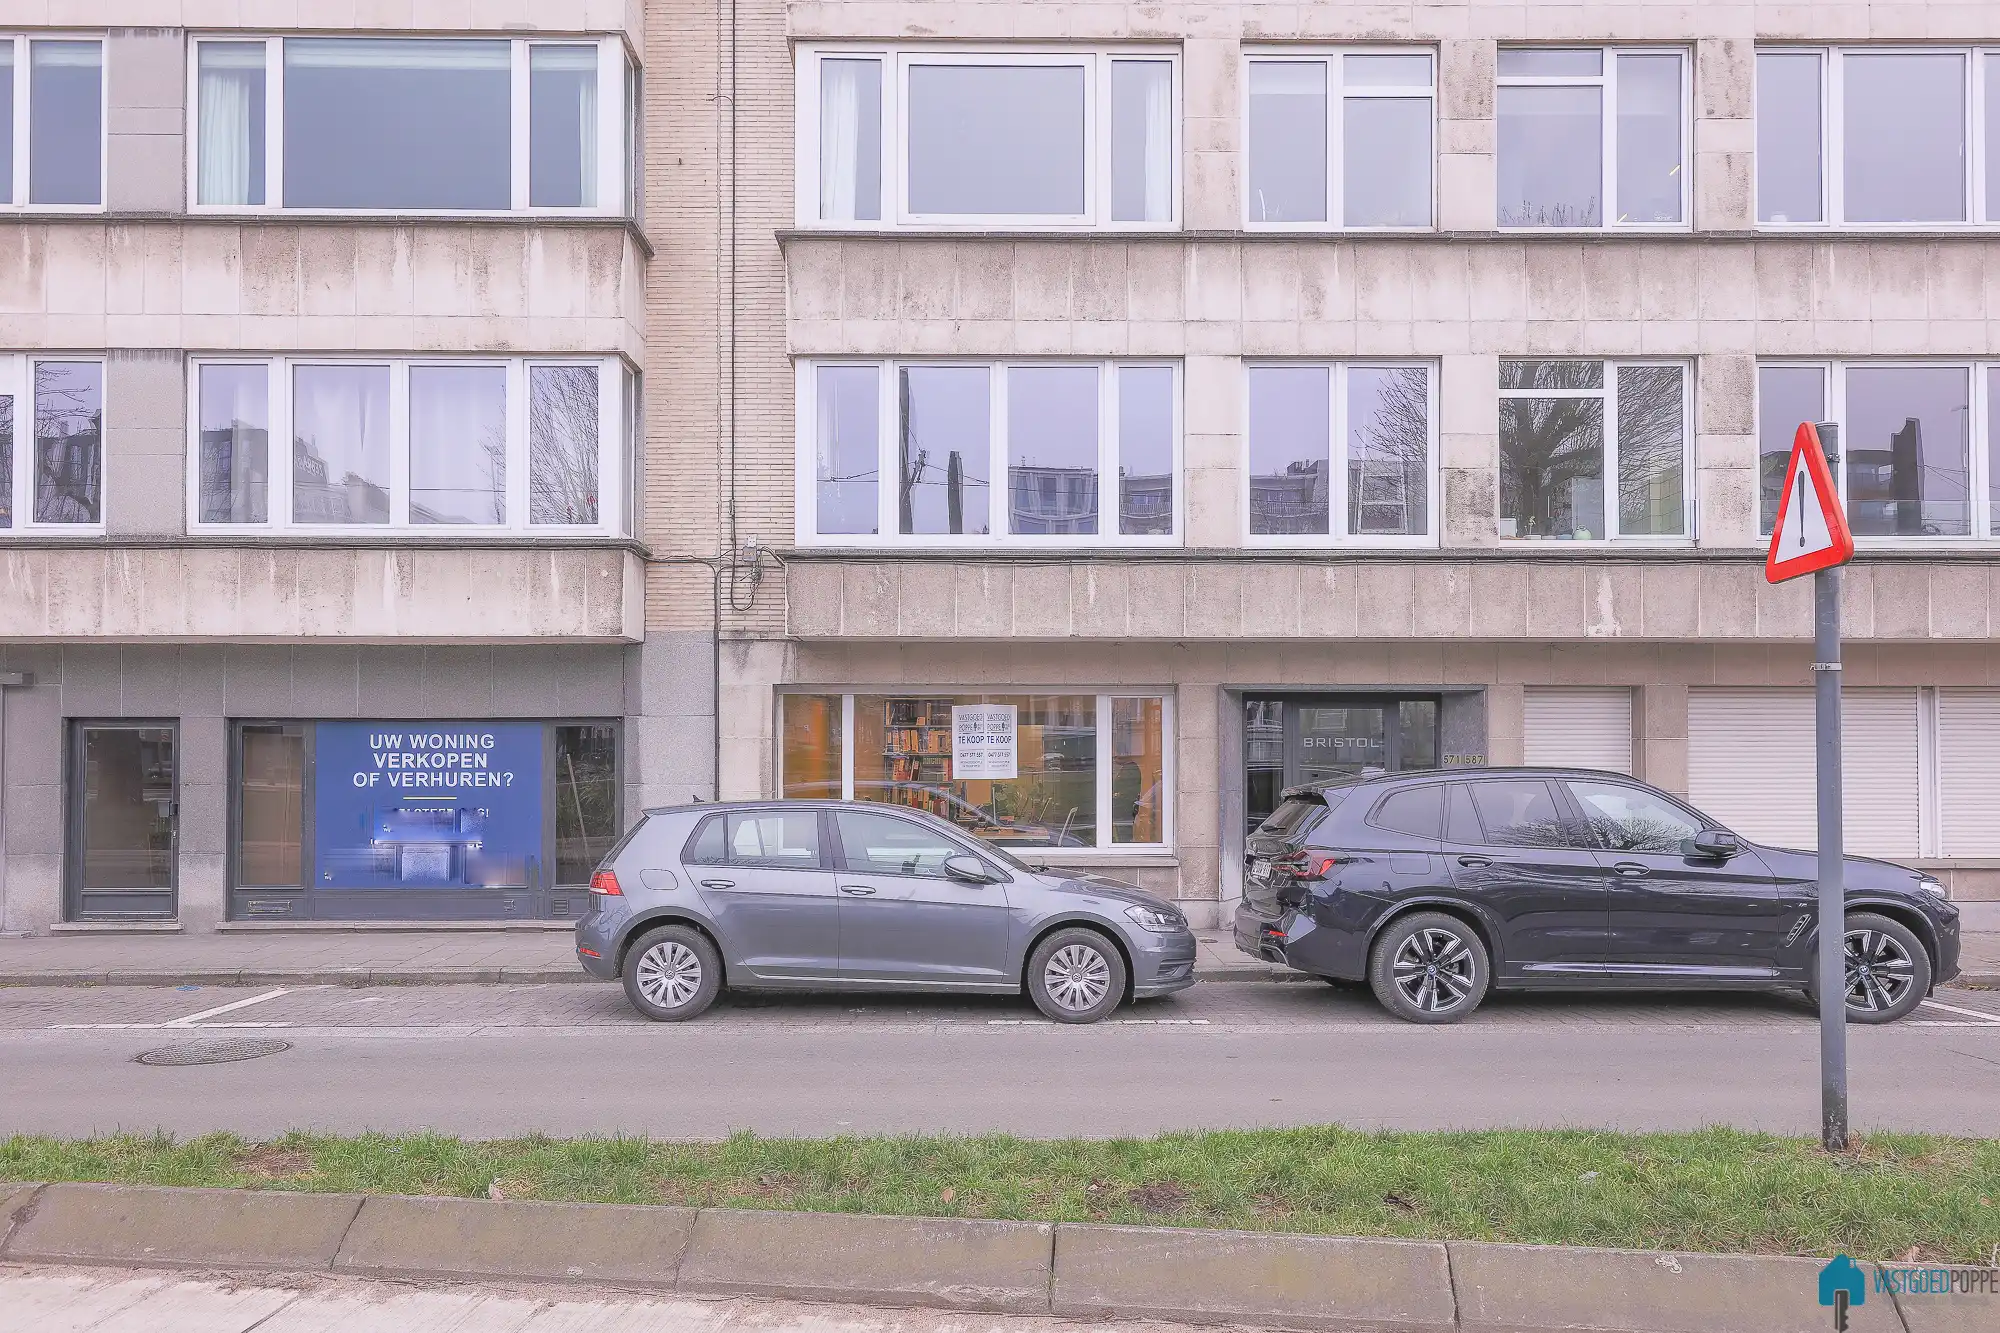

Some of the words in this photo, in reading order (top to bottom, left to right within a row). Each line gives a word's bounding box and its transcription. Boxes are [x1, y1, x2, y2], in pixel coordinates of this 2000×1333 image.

[369, 734, 402, 749] UW
[409, 734, 495, 749] WONING
[958, 735, 966, 744] TE
[967, 735, 985, 744] KOOP
[986, 735, 995, 744] TE
[996, 735, 1012, 744] KOOP
[1303, 737, 1380, 748] BRISTOL
[373, 752, 487, 768] VERKOPEN
[1443, 755, 1460, 764] 571
[1465, 755, 1483, 764] 587
[353, 772, 380, 787] OF
[387, 772, 514, 787] VERHUREN?
